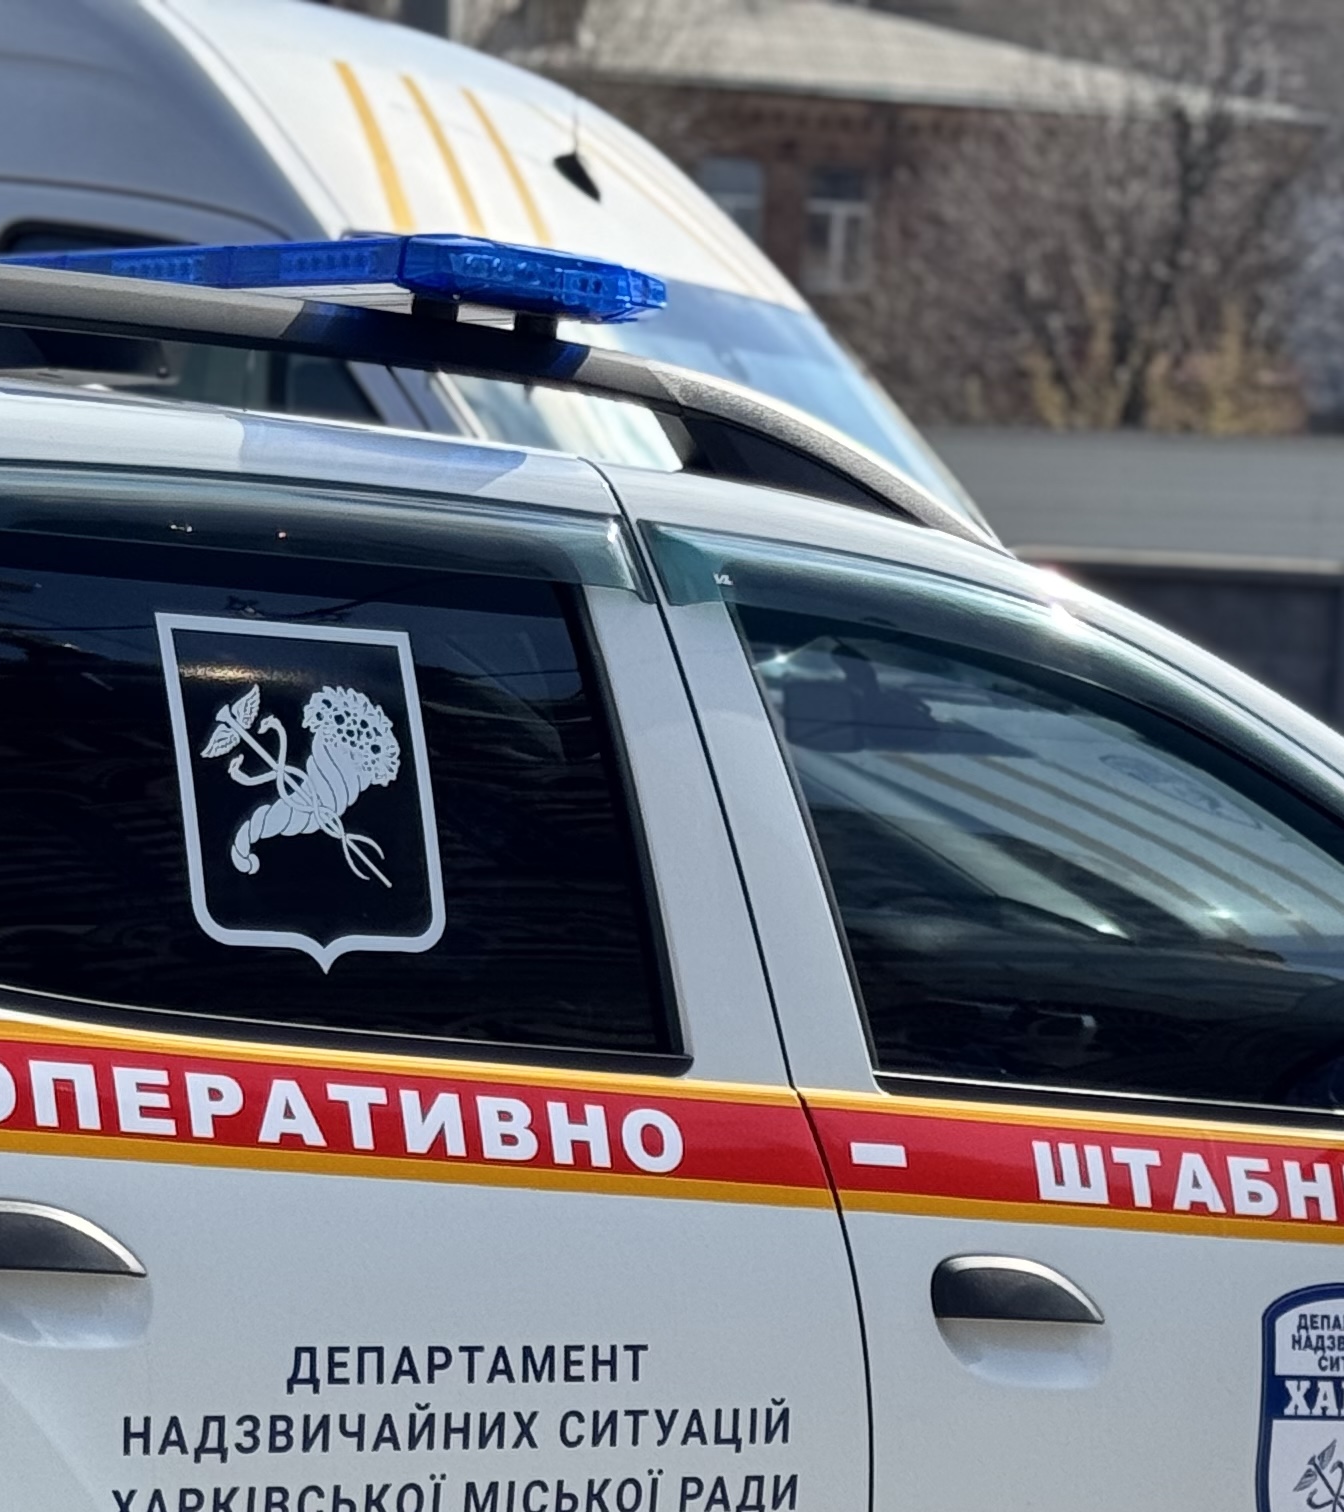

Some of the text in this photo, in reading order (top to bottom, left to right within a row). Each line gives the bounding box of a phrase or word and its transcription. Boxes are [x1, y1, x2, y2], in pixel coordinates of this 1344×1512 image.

[286, 1343, 649, 1395] ДЕПАРТАМЕНТ
[122, 1397, 791, 1464] НАДЗВИЧАЙНИХ СИТУАЦІЙ
